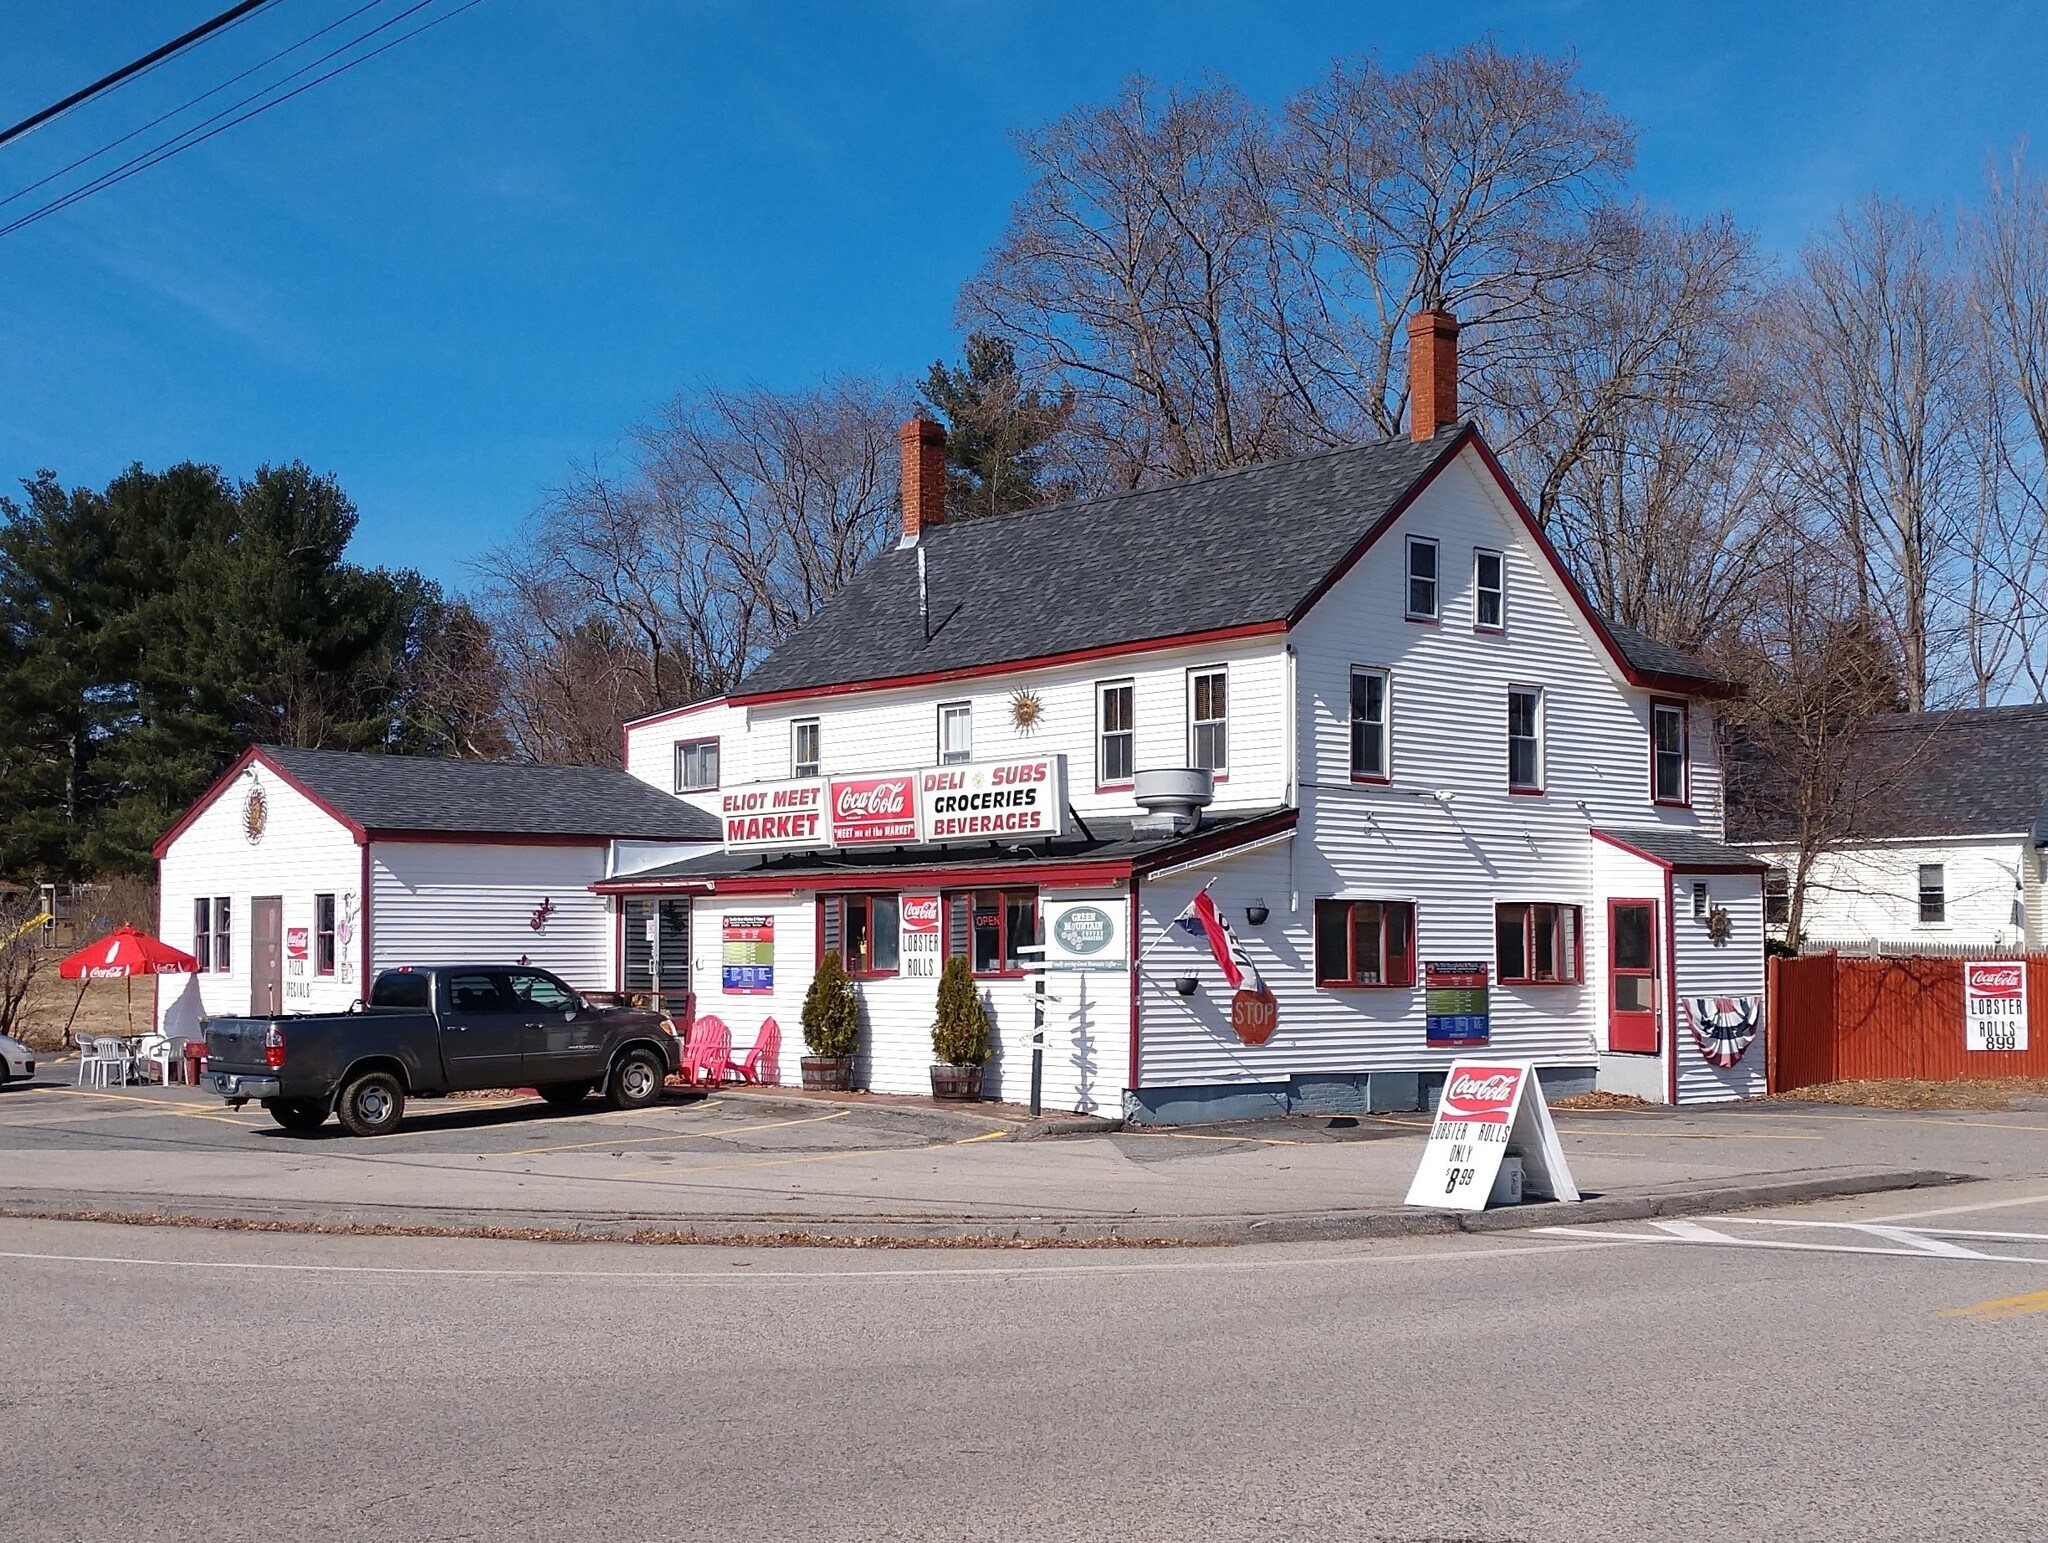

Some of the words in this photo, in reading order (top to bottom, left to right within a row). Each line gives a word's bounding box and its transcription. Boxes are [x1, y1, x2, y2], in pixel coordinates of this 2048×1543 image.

[924, 771, 966, 792] DELI
[992, 763, 1047, 786] SUBS
[723, 792, 768, 812] ELIOT
[773, 787, 821, 808] MEET
[837, 781, 906, 817] Coca-Cola
[935, 788, 1037, 813] GROCERIES
[728, 813, 820, 841] MARKET
[864, 827, 871, 837] at
[873, 826, 883, 837] the
[934, 811, 1041, 835] BEVERAGES
[904, 901, 937, 920] Coca-Cola
[1071, 912, 1096, 921] GREEN
[976, 916, 1000, 926] OPEN
[1063, 921, 1104, 931] MOUNTAIN
[287, 931, 308, 948] Coca-Cola
[902, 934, 939, 952] LOBSTER
[90, 966, 123, 978] Coca-Cola
[289, 960, 304, 976] PIZZA
[908, 958, 934, 976] ROLLS
[1972, 970, 2021, 986] Coca-Cola
[286, 981, 310, 998] SPECIALS
[1234, 1001, 1274, 1025] STOP
[1971, 999, 2022, 1015] LOBSTER
[1979, 1021, 2015, 1037] ROLLS
[1986, 1036, 2015, 1050] 899
[1449, 1074, 1519, 1101] Coca-Cola
[1430, 1122, 1468, 1141] LOBSTER
[1478, 1123, 1510, 1143] ROLLS
[1449, 1144, 1473, 1163] ONLY
